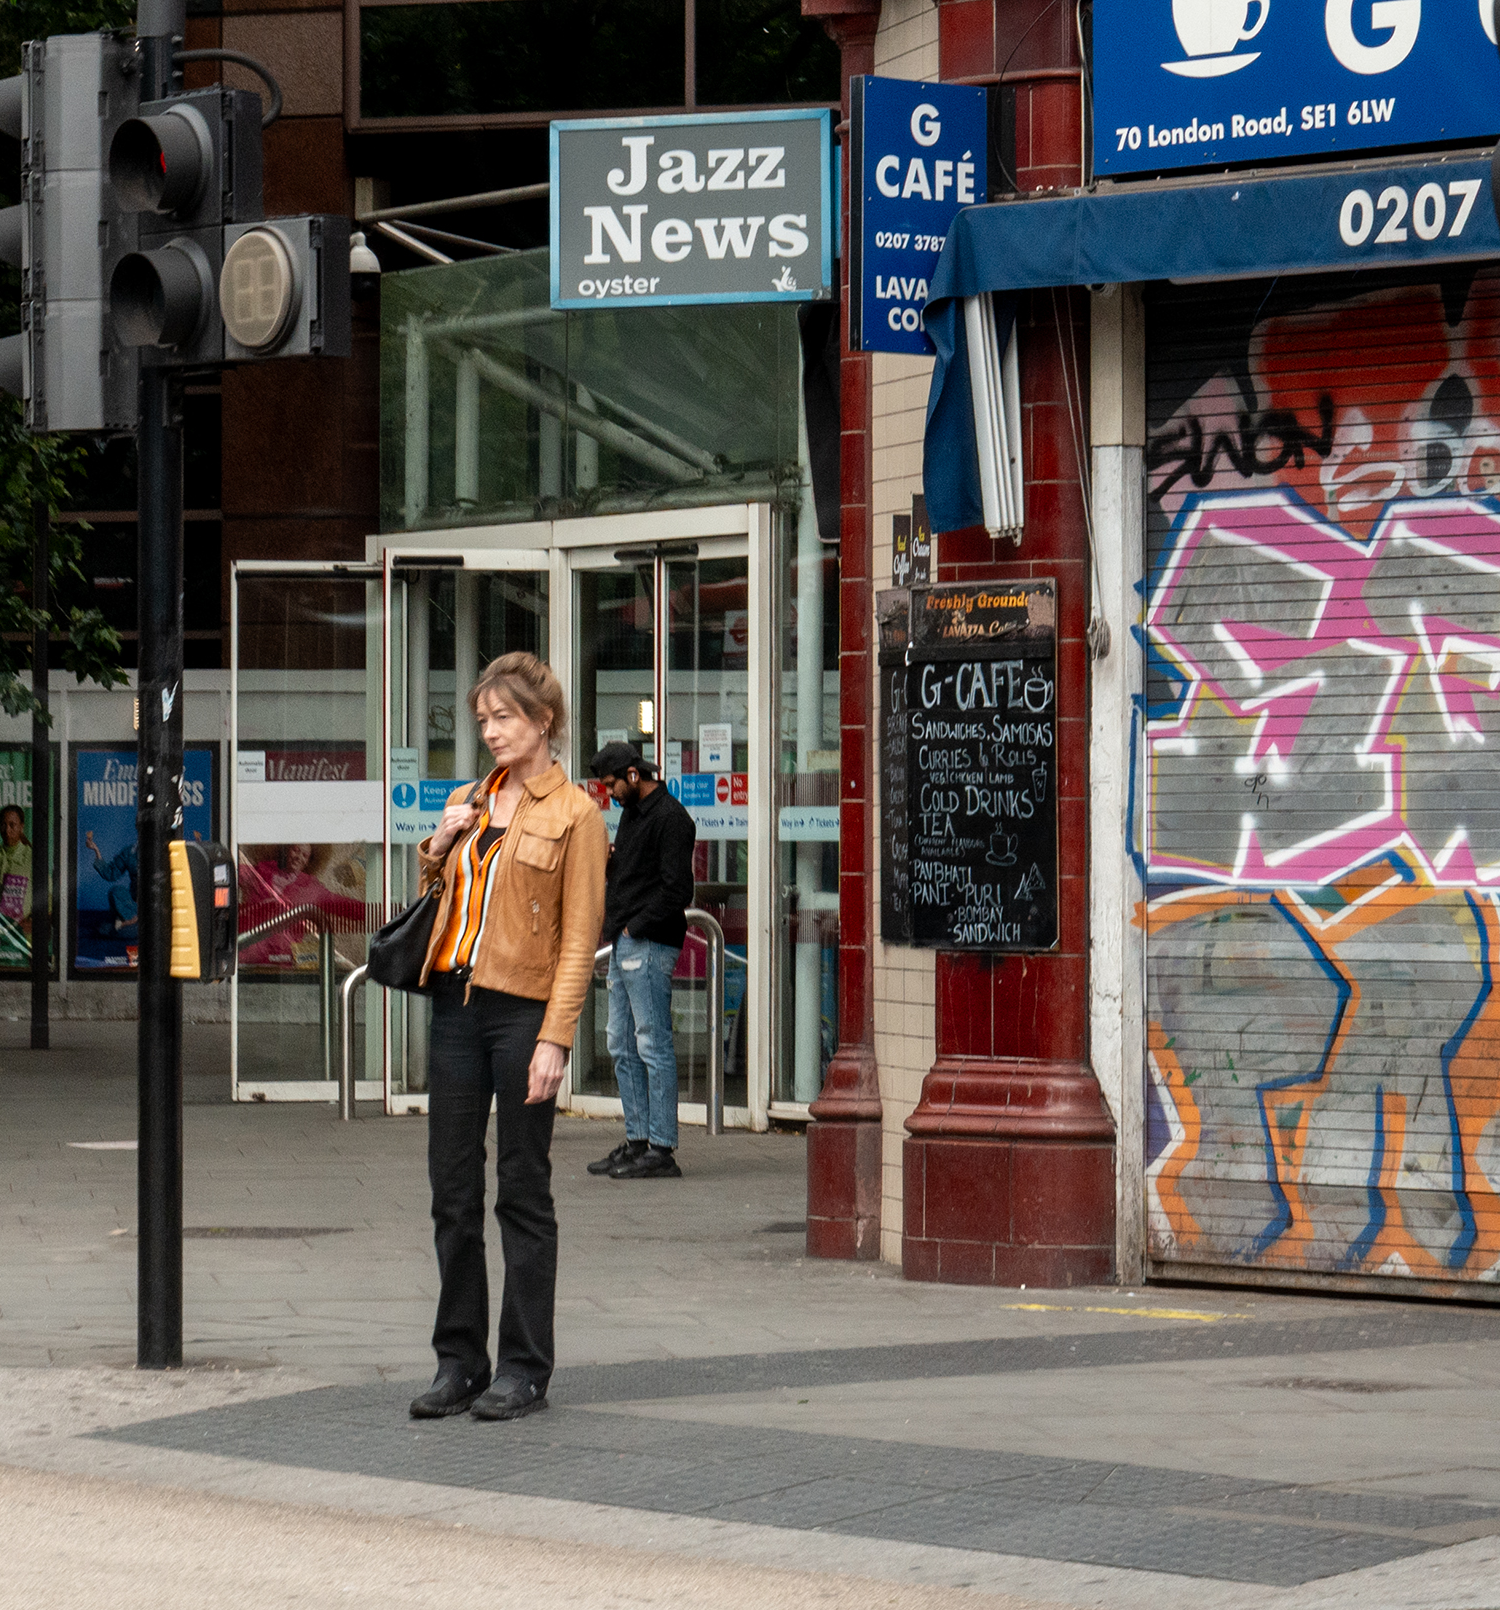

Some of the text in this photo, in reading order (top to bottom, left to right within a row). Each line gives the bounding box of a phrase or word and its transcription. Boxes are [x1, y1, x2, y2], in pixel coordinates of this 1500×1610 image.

[910, 103, 942, 147] G
[1115, 98, 1396, 152] 70 London Road, SE1 6LW
[606, 135, 786, 196] Jazz
[875, 149, 976, 205] CAFÉ
[1339, 178, 1483, 248] 0207
[583, 203, 810, 265] News
[875, 231, 911, 250] 0207
[578, 274, 660, 298] oyster
[926, 590, 1041, 614] Freshly Ground
[921, 659, 1024, 711] G-CAFE
[992, 714, 1053, 747] SAMOSAS
[918, 745, 972, 771] CURRIES
[83, 779, 204, 808] MINDFSS
[424, 786, 446, 797] Keep
[733, 778, 743, 788] No
[920, 783, 960, 813] COLD
[965, 785, 1035, 820] DRINKS
[395, 822, 427, 833] Way in
[701, 818, 719, 828] Tickets
[918, 812, 956, 838] TEA
[953, 922, 1021, 944] SANDWICH
